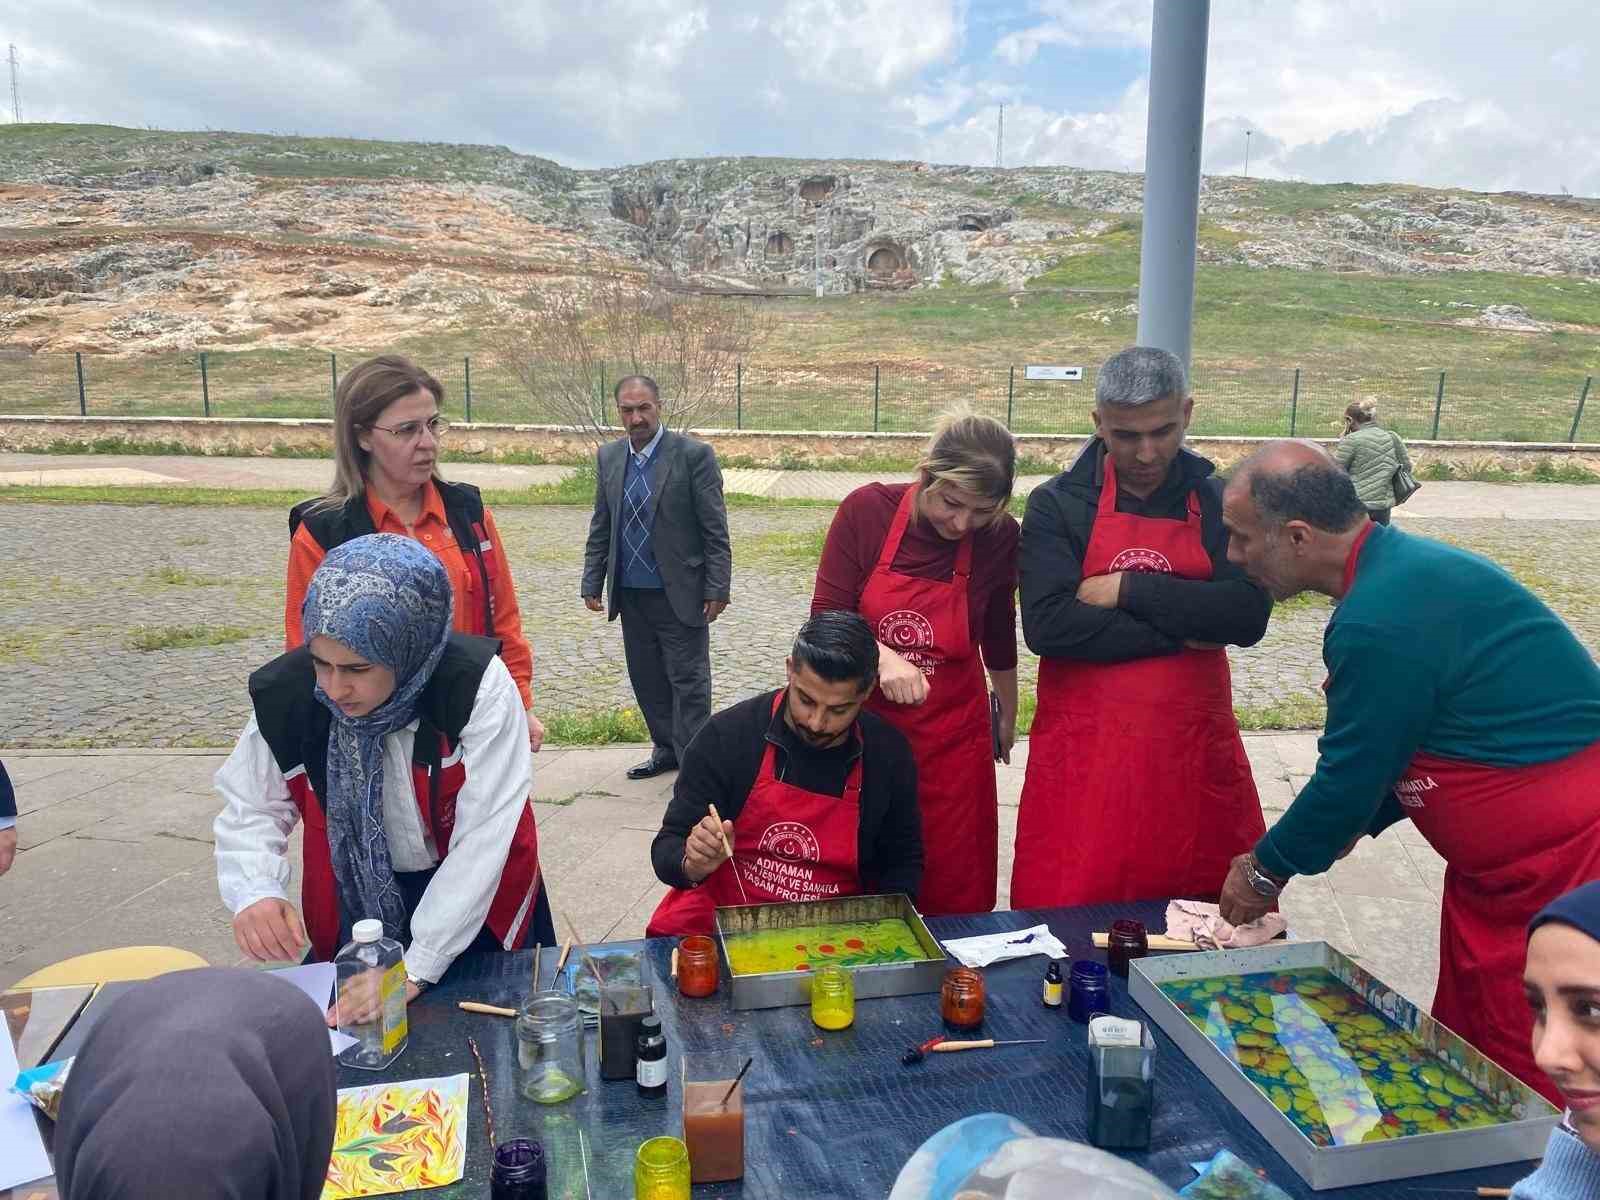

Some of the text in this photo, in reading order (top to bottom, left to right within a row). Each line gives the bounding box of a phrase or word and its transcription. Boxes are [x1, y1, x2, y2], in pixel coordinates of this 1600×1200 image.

[757, 857, 813, 880] ADIYAMAN
[789, 877, 801, 891] VE
[802, 881, 840, 894] SANATLA
